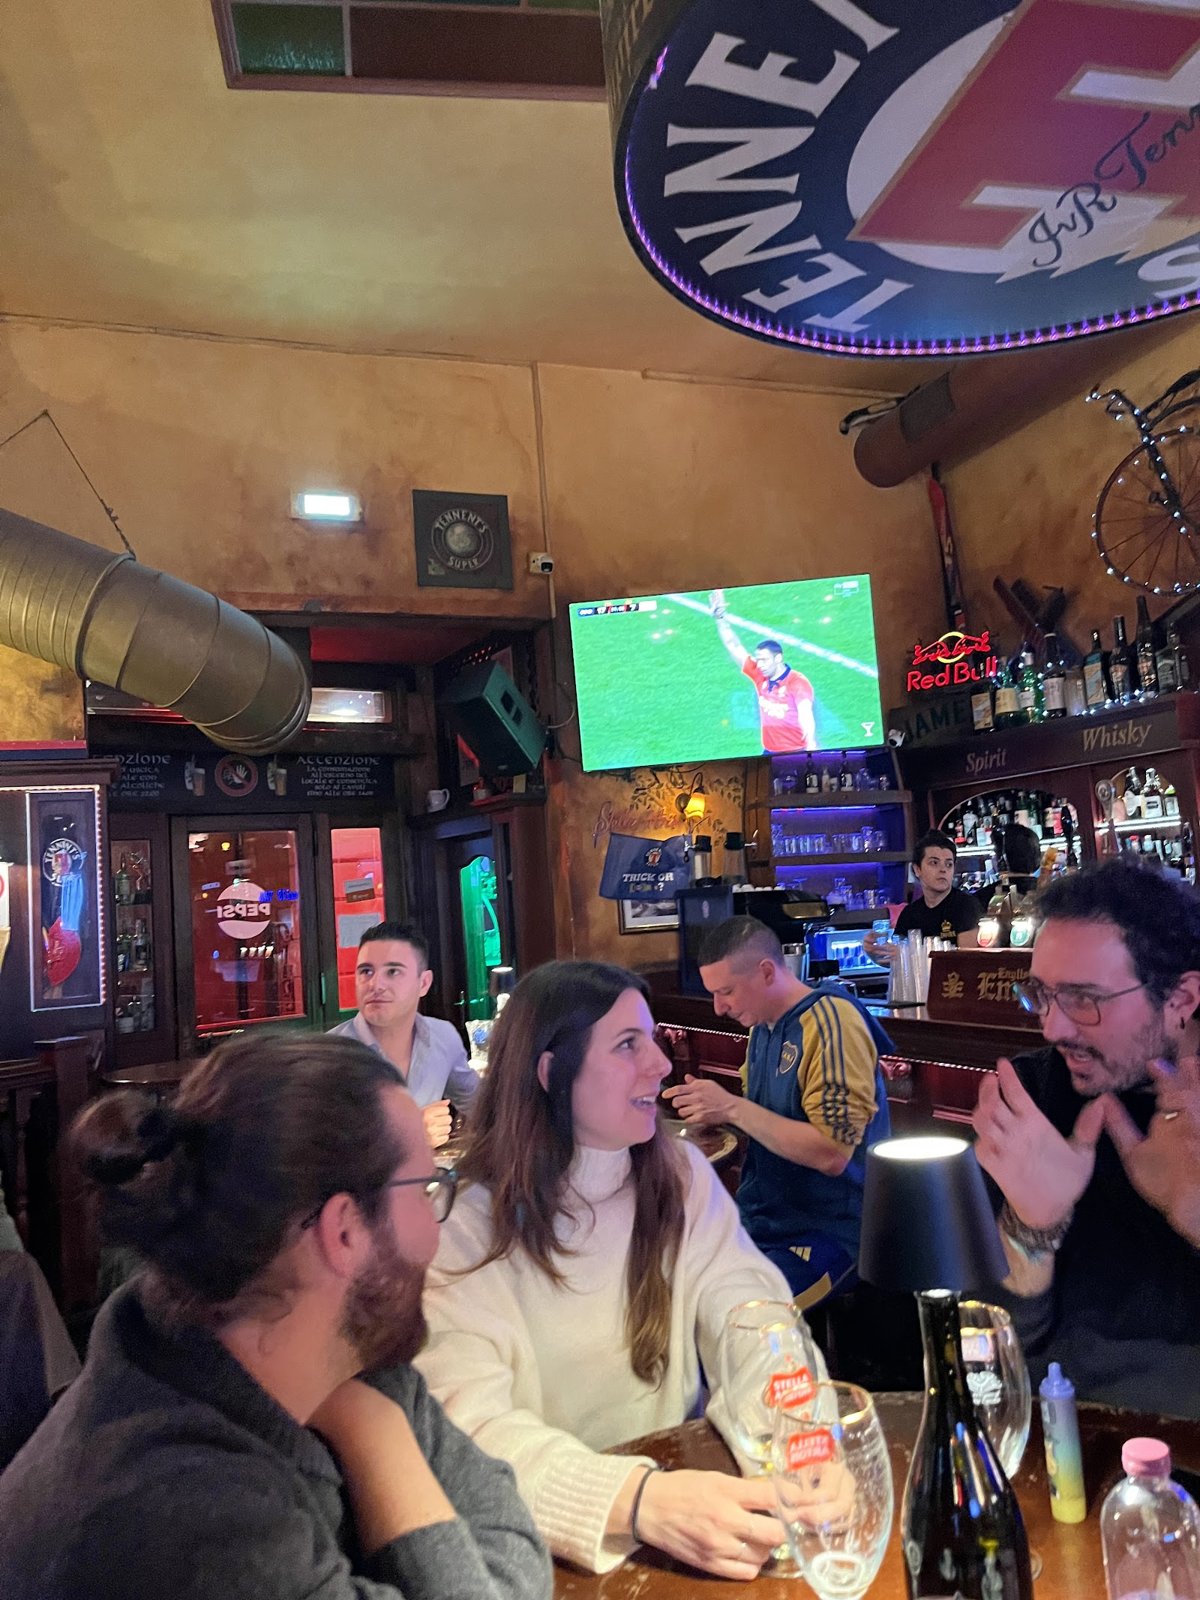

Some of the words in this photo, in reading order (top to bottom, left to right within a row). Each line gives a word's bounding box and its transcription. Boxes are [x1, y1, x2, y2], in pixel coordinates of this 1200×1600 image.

[448, 556, 480, 569] SUPER
[906, 664, 950, 692] Red
[953, 655, 998, 685] Bull
[1082, 719, 1152, 752] Whisky
[966, 749, 1007, 774] Spirit
[622, 872, 657, 882] TRICK
[657, 872, 674, 882] OR
